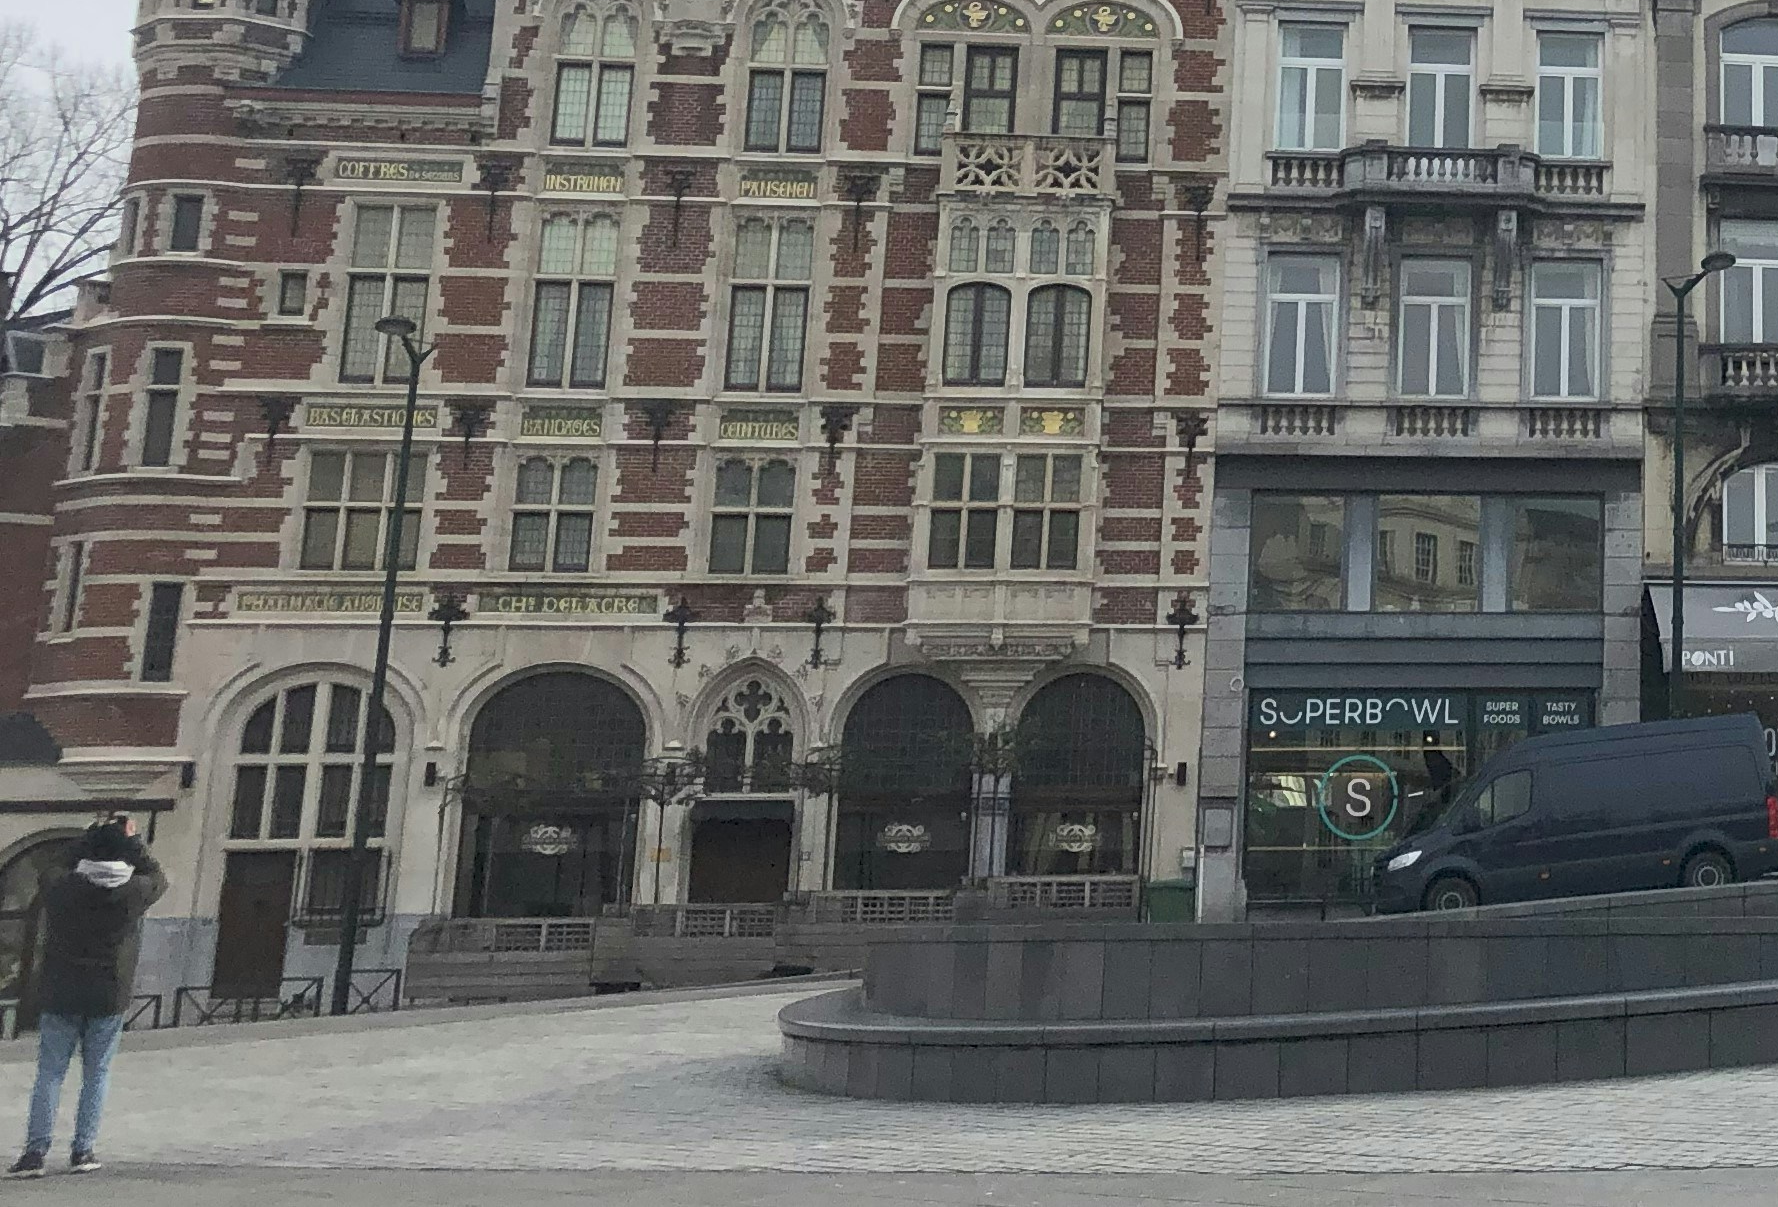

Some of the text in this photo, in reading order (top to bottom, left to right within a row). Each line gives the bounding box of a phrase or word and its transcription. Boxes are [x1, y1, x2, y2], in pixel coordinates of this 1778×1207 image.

[339, 161, 409, 179] COFFRES
[308, 408, 341, 425] BAS
[523, 418, 600, 436] BANDAGES
[720, 422, 798, 439] CEINTURES
[242, 595, 339, 611] PHARMACIE
[541, 597, 640, 614] DELACRE
[1681, 647, 1735, 667] PONTI
[1259, 697, 1460, 725] SUPERBOWL
[1486, 701, 1519, 712] SUPER
[1546, 702, 1577, 712] TASTY
[1483, 714, 1521, 724] FOODS
[1542, 715, 1580, 725] BOWLS
[1346, 778, 1371, 817] S
